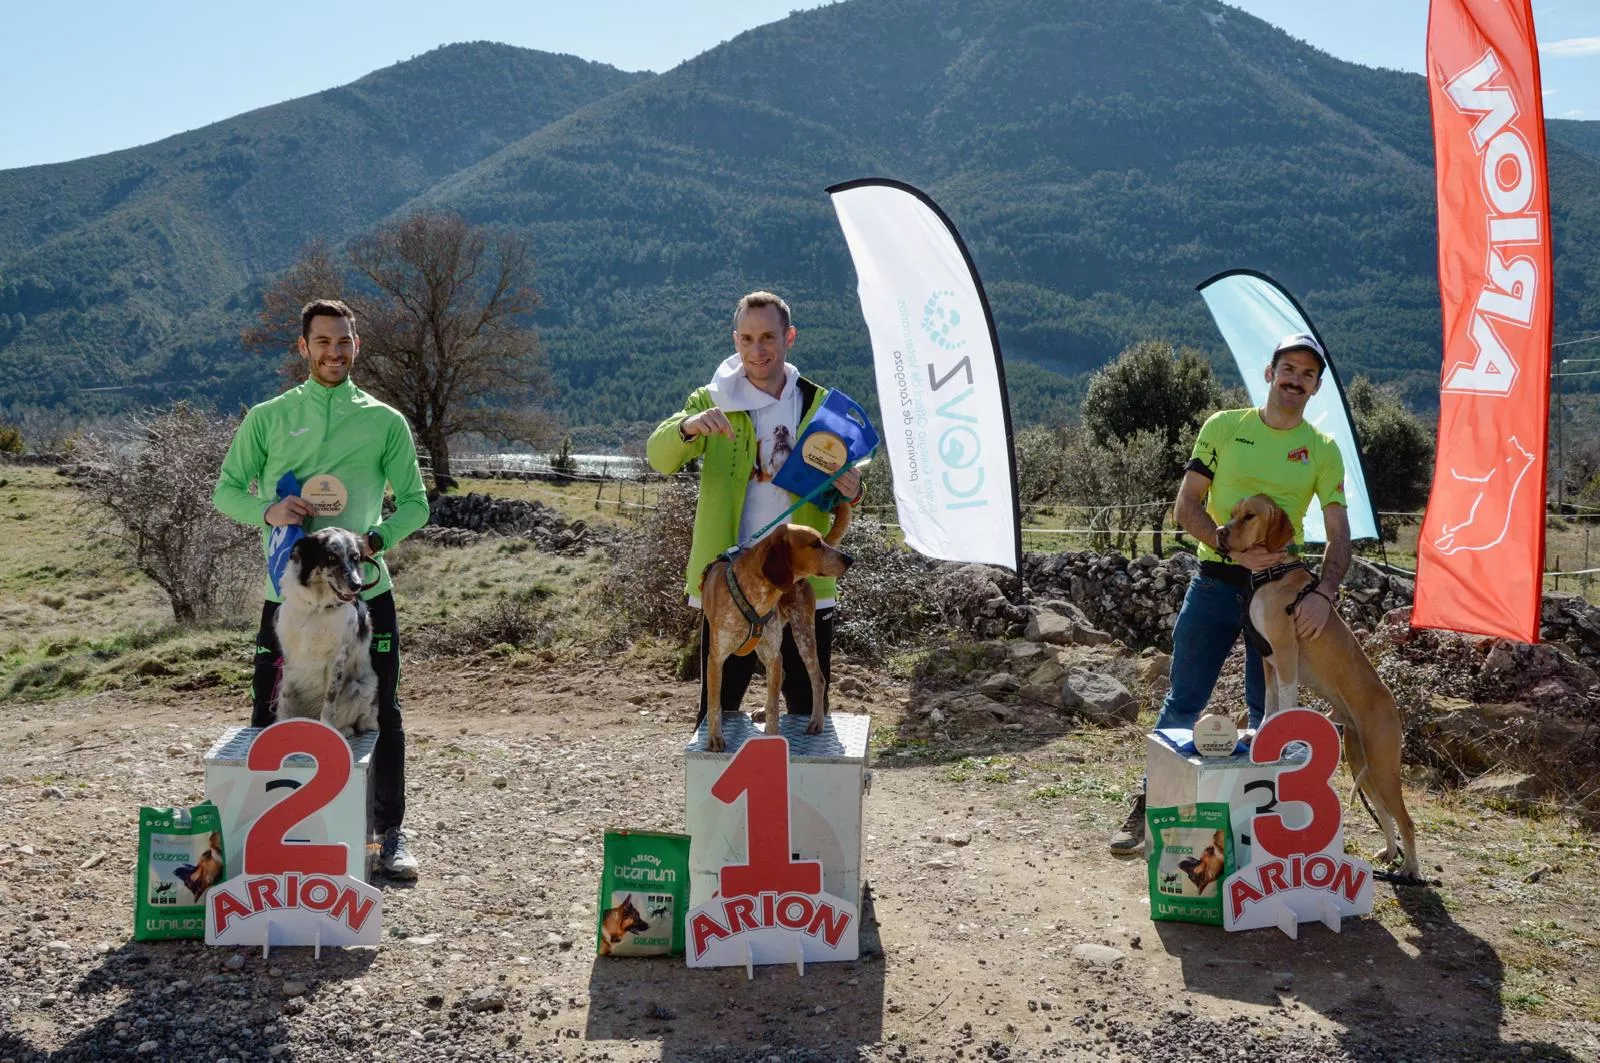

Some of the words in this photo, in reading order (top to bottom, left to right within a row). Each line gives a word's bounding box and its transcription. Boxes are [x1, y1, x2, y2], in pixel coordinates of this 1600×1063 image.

[245, 721, 351, 876] 2
[711, 738, 822, 898] 1
[1253, 709, 1341, 858] 3
[615, 865, 676, 882] titanium
[630, 854, 662, 867] ARION
[1228, 855, 1369, 924] ARION
[146, 918, 205, 931] tanium
[213, 873, 377, 938] ARION
[690, 892, 852, 961] ARION
